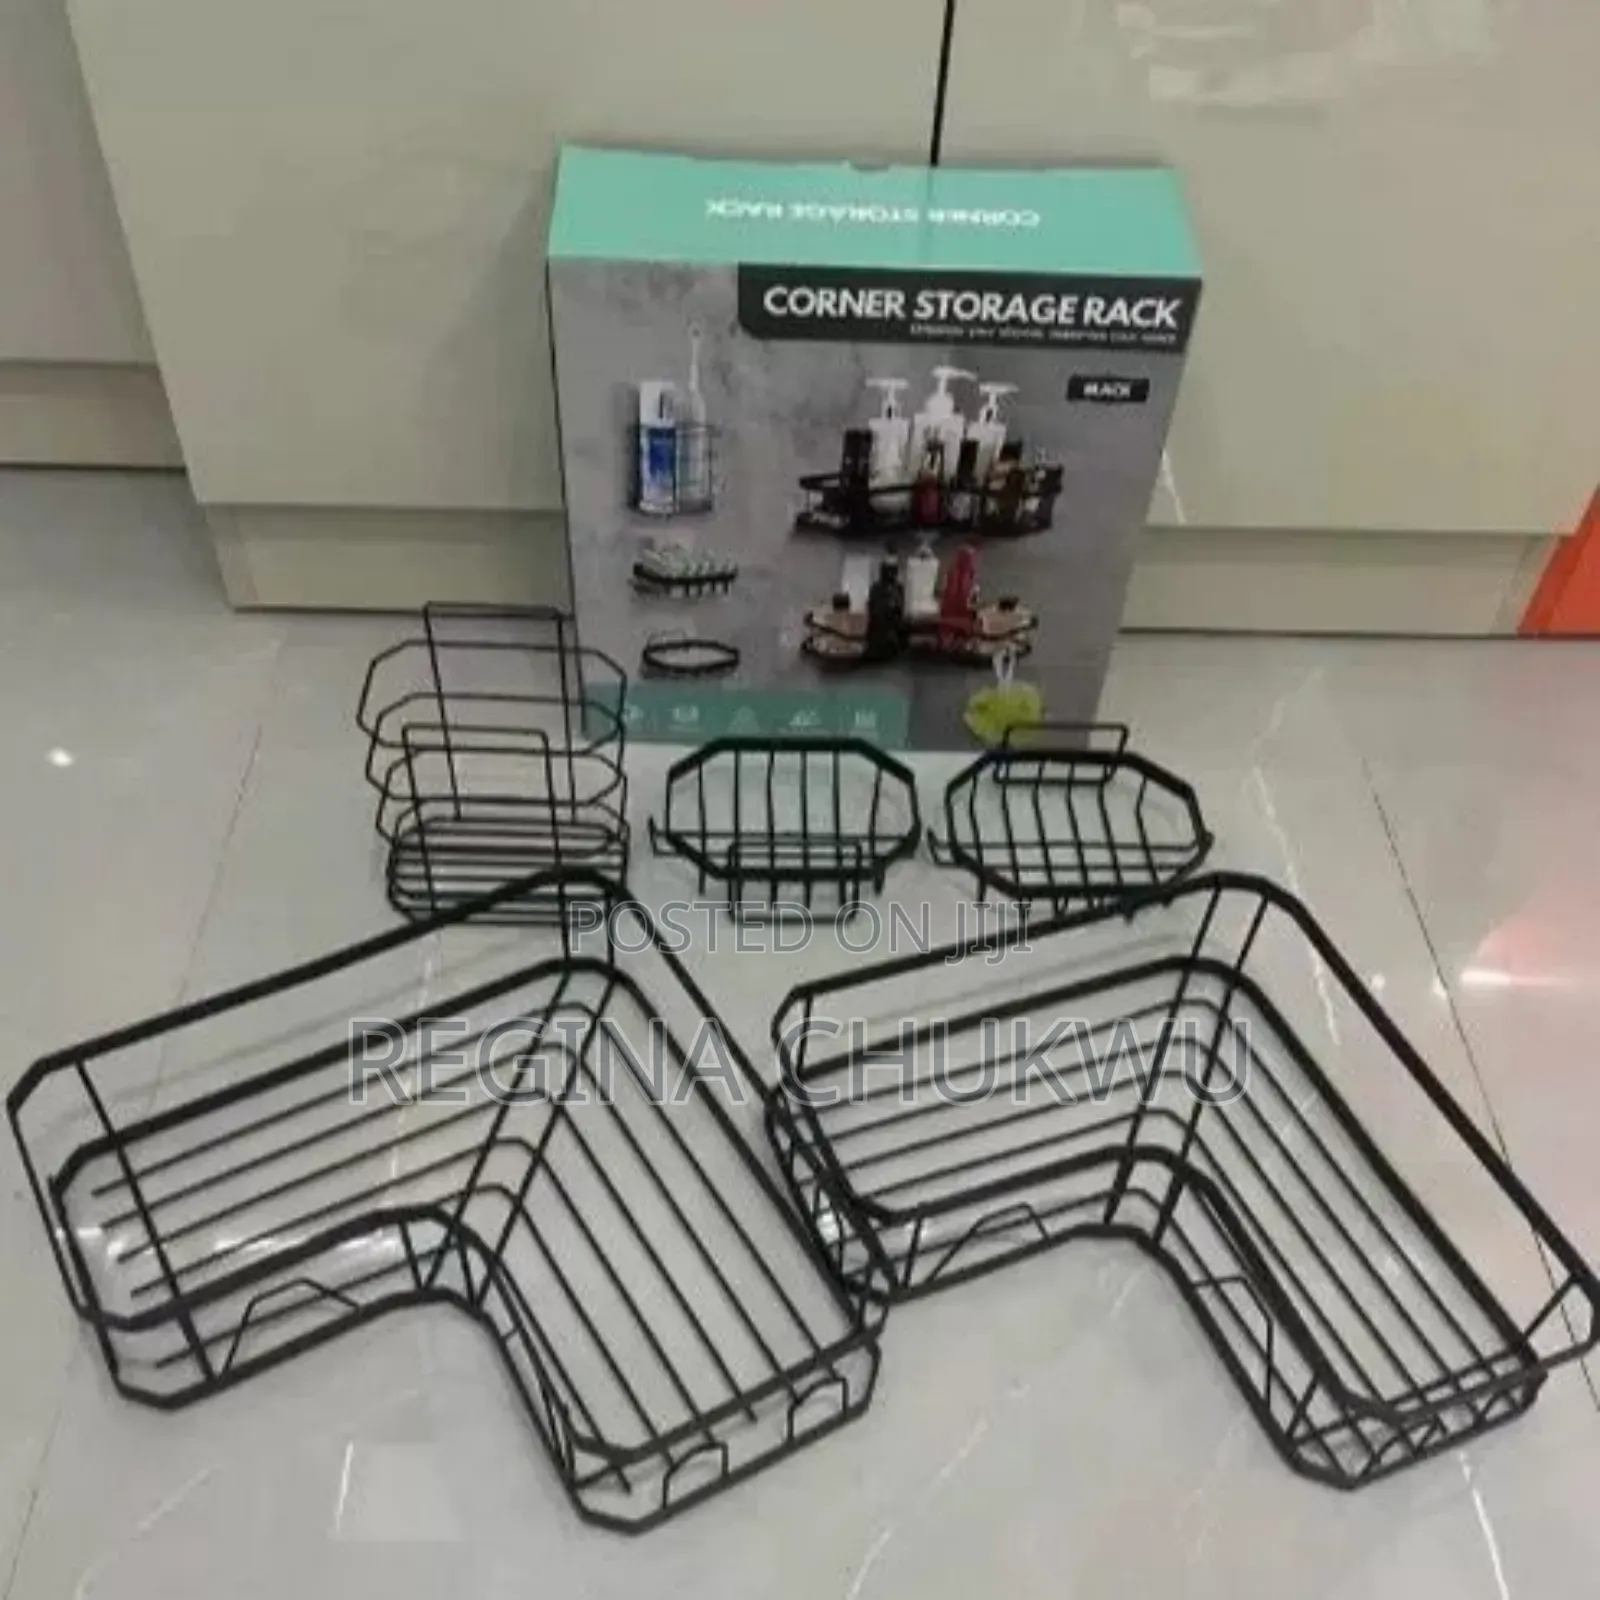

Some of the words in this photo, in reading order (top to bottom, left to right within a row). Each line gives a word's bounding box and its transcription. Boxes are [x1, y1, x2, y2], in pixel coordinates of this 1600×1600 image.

[763, 285, 906, 319] CORNER
[912, 289, 1076, 325] STORAGE
[1082, 297, 1182, 328] RACK
